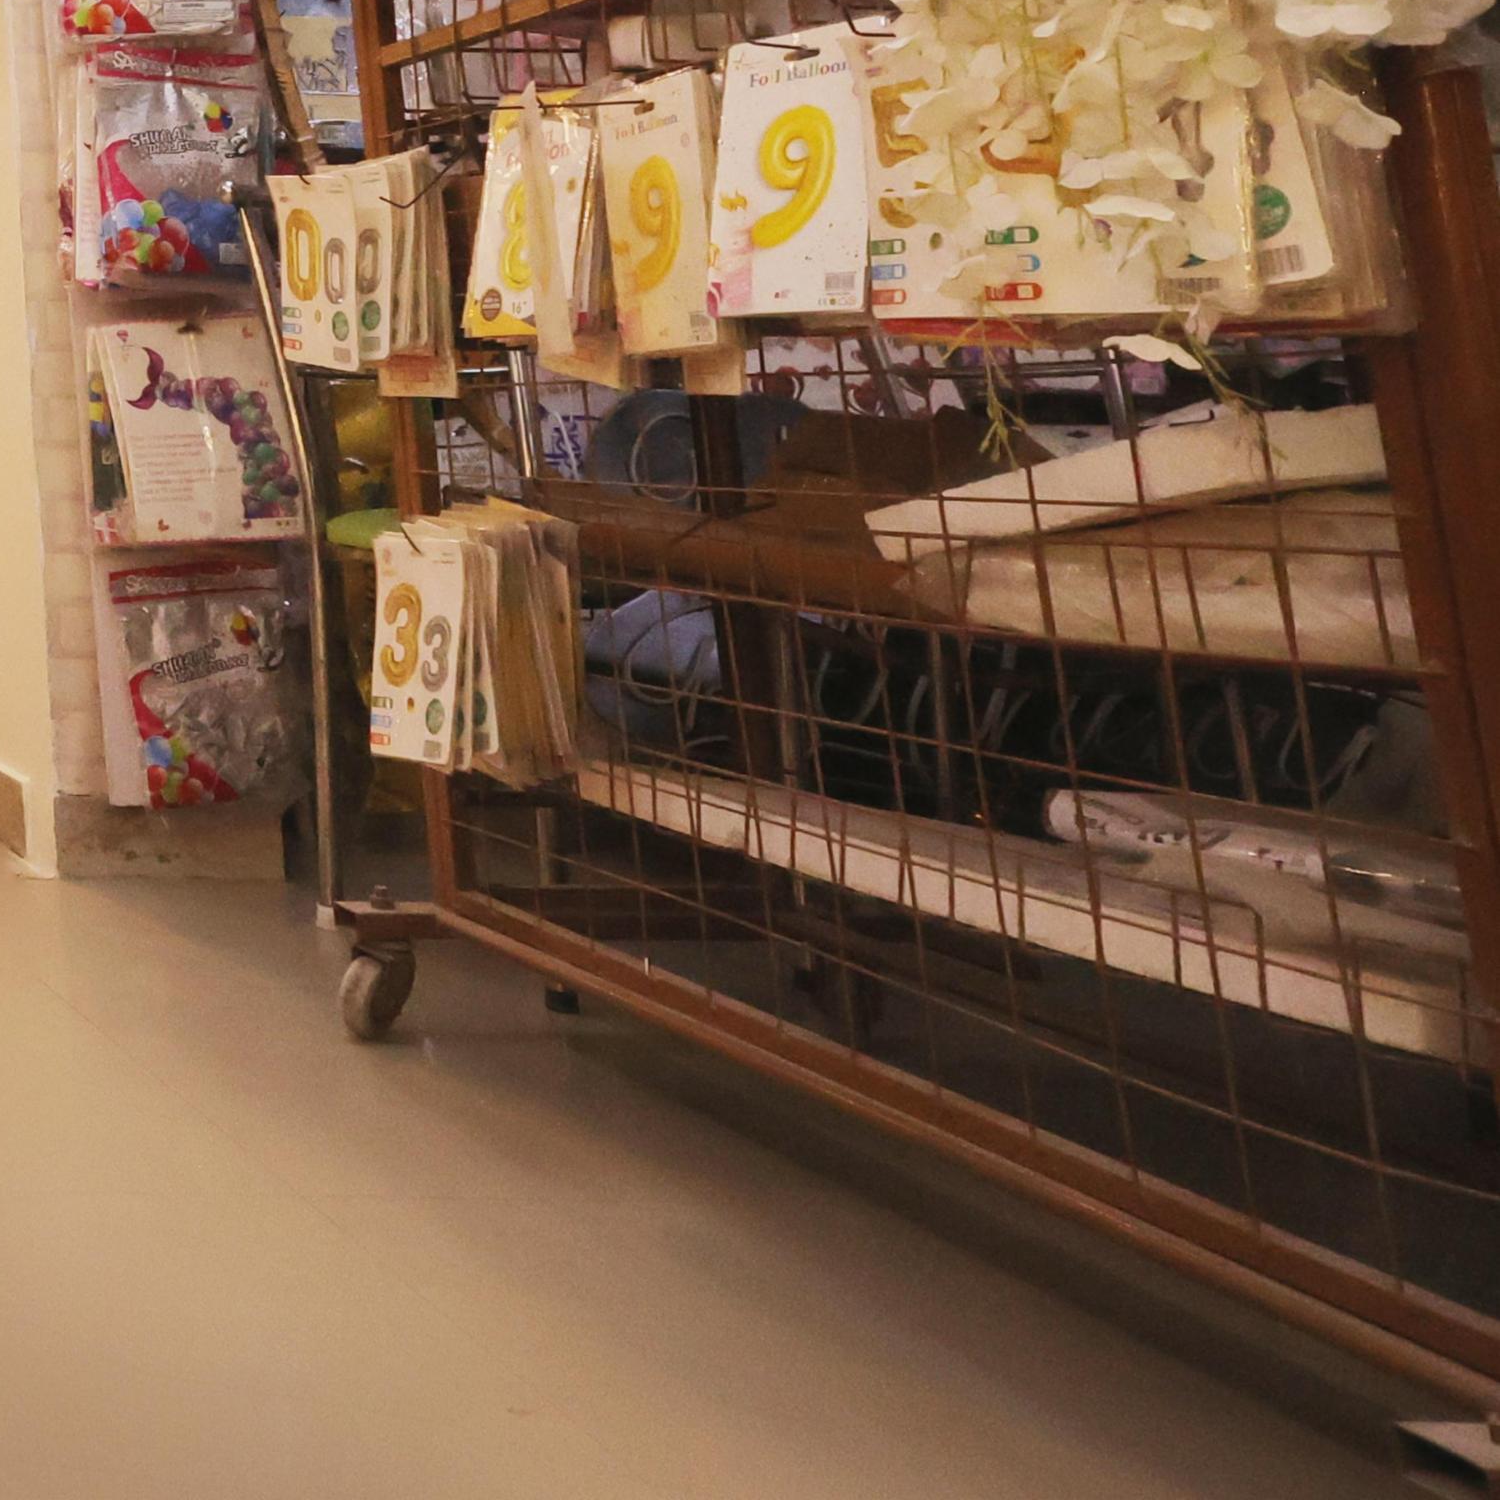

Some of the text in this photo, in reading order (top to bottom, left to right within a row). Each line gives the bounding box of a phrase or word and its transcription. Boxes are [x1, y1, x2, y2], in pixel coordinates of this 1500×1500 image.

[630, 154, 681, 298] 9
[750, 104, 837, 249] 9
[380, 582, 423, 688] 3
